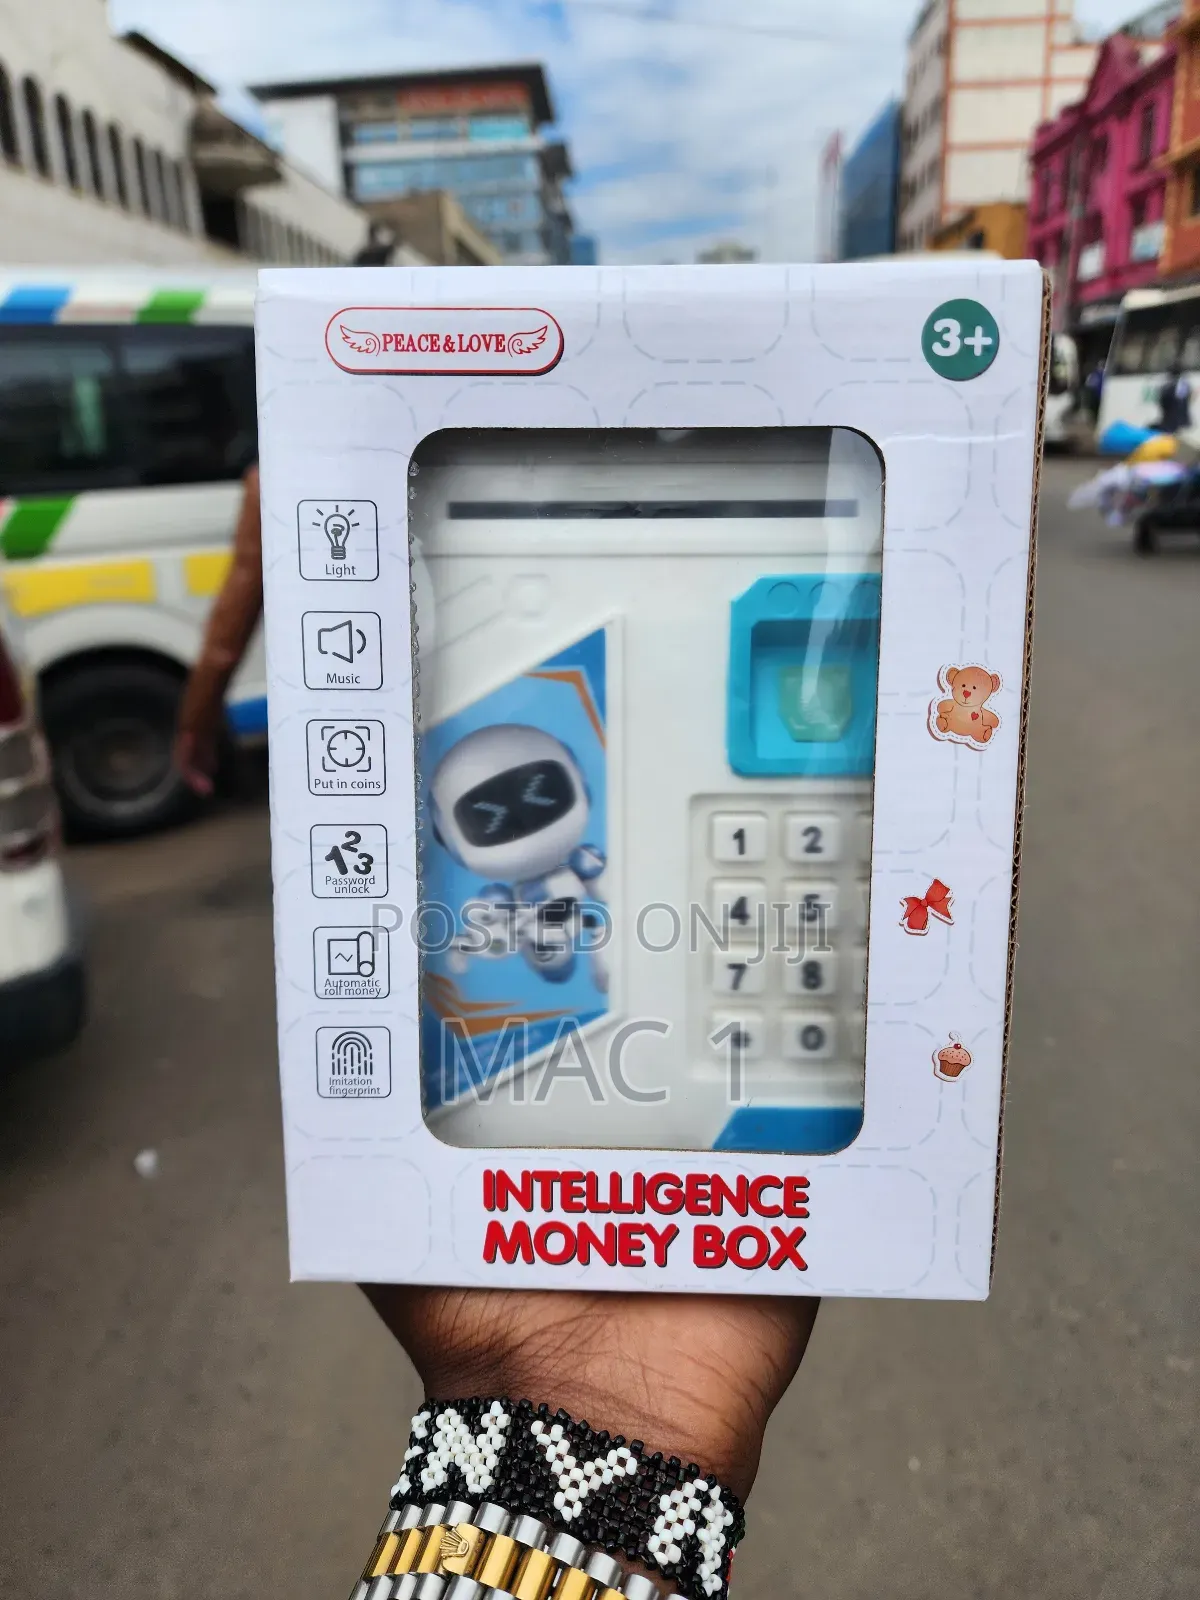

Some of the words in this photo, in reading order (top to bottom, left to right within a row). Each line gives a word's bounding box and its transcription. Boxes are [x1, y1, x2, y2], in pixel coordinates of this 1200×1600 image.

[931, 318, 993, 357] 3+
[325, 563, 357, 578] Light
[326, 672, 361, 685] Music
[314, 778, 334, 789] Put
[337, 778, 348, 789] in
[351, 778, 381, 790] coins
[732, 828, 746, 856] 1
[801, 826, 823, 854] 2
[325, 875, 376, 886] Password
[334, 884, 370, 894] unlock
[730, 896, 751, 926] 4
[727, 963, 747, 991] 7
[801, 960, 823, 990] 8
[324, 978, 380, 988] Automatic
[324, 986, 342, 996] roll
[344, 988, 381, 999] money
[329, 1077, 373, 1086] Imitation
[329, 1086, 381, 1098] fingerprint
[483, 1169, 810, 1218] INTELLIGENCE
[482, 1220, 680, 1268] MONEY
[693, 1224, 808, 1271] BOX
